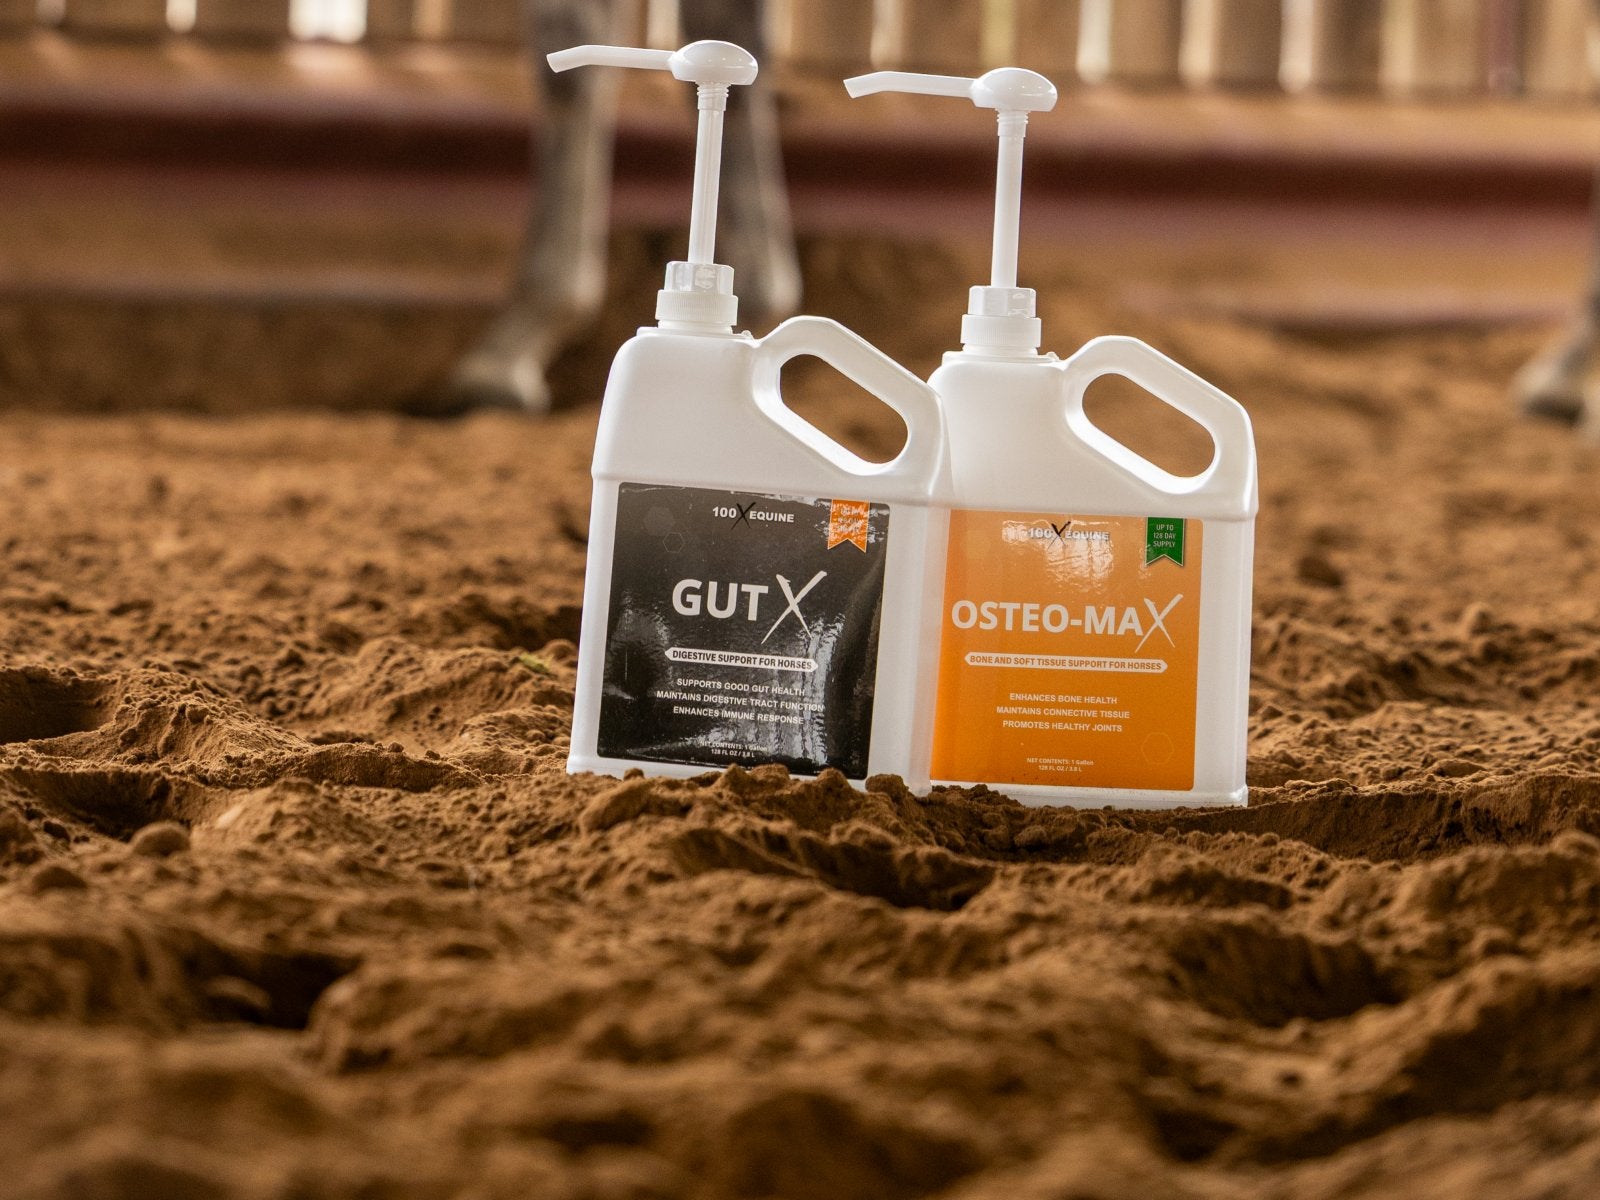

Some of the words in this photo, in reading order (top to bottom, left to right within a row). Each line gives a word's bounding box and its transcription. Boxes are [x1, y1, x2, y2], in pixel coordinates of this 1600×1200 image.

[749, 510, 795, 523] EQUINE
[672, 578, 769, 621] GUT
[951, 593, 1184, 653] OSTEO-MAX
[672, 650, 716, 662] DIGESTIVE
[718, 652, 757, 665] SUPPORT
[759, 658, 776, 667] FOR
[778, 659, 812, 670] HORSES
[970, 655, 993, 664] BONE
[994, 656, 1012, 664] AND
[1014, 657, 1035, 666] SOFT
[1037, 658, 1067, 667] TISSUE
[1068, 659, 1108, 668] SUPPORT
[1109, 660, 1126, 669] FOR
[1127, 661, 1161, 670] HORSES
[676, 678, 722, 689] SUPPORTS
[724, 682, 750, 692] GOOD
[752, 684, 770, 693] GUT
[772, 686, 805, 696] HEALTH
[656, 691, 701, 701] MAINTAINS
[703, 695, 747, 705] DIGESTIVE
[750, 699, 778, 708] TRACT
[780, 701, 824, 712] FUNCTION
[1009, 693, 1056, 702] ENHANCES
[1058, 695, 1082, 703] BONE
[1084, 696, 1117, 704] HEALTH
[673, 706, 719, 717] ENHANCES
[721, 710, 755, 720] IMMUNE
[757, 714, 804, 725] RESPONSE
[996, 706, 1041, 715] MAINTAINS
[1043, 708, 1098, 718] CONNECTIVE
[1100, 710, 1130, 719] TISSUE
[1002, 720, 1049, 729] PROMOTES
[1052, 722, 1090, 731] HEALTHY
[1092, 723, 1122, 732] JOINTS
